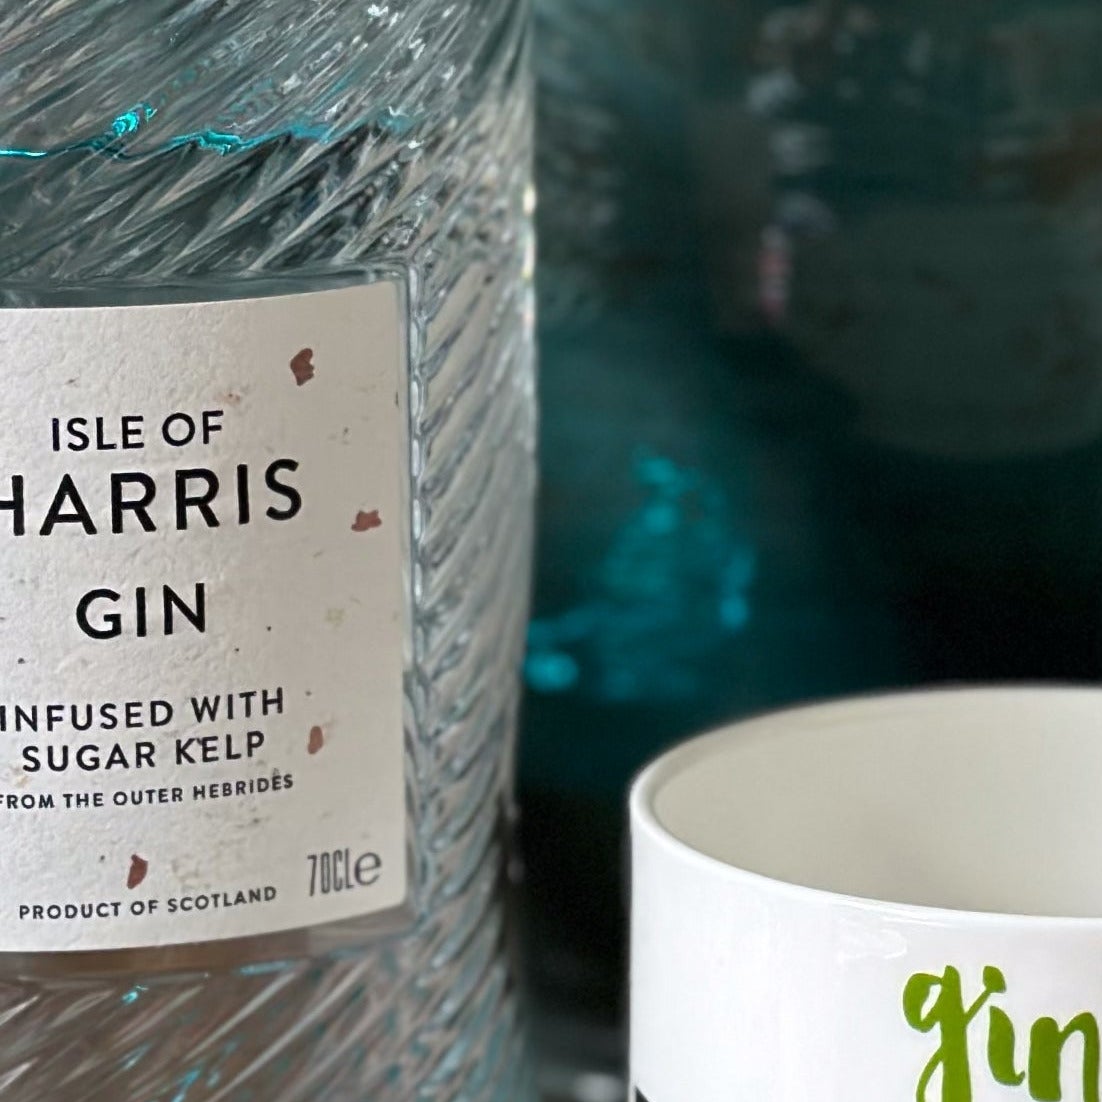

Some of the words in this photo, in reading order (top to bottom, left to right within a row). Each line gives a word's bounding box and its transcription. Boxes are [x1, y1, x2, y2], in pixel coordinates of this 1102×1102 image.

[52, 414, 146, 452] ISLE
[161, 409, 225, 446] OF
[75, 582, 207, 640] GIN
[0, 699, 174, 732] INFUSED
[190, 687, 285, 723] WITH
[22, 742, 156, 772] SUGAR
[175, 730, 266, 765] KELP
[62, 793, 104, 808] THE
[112, 786, 184, 806] OUTER
[192, 773, 294, 801] HEBRIDES
[19, 902, 122, 920] PRODUCT
[131, 899, 159, 916] OF
[167, 886, 277, 912] SCOTLAND
